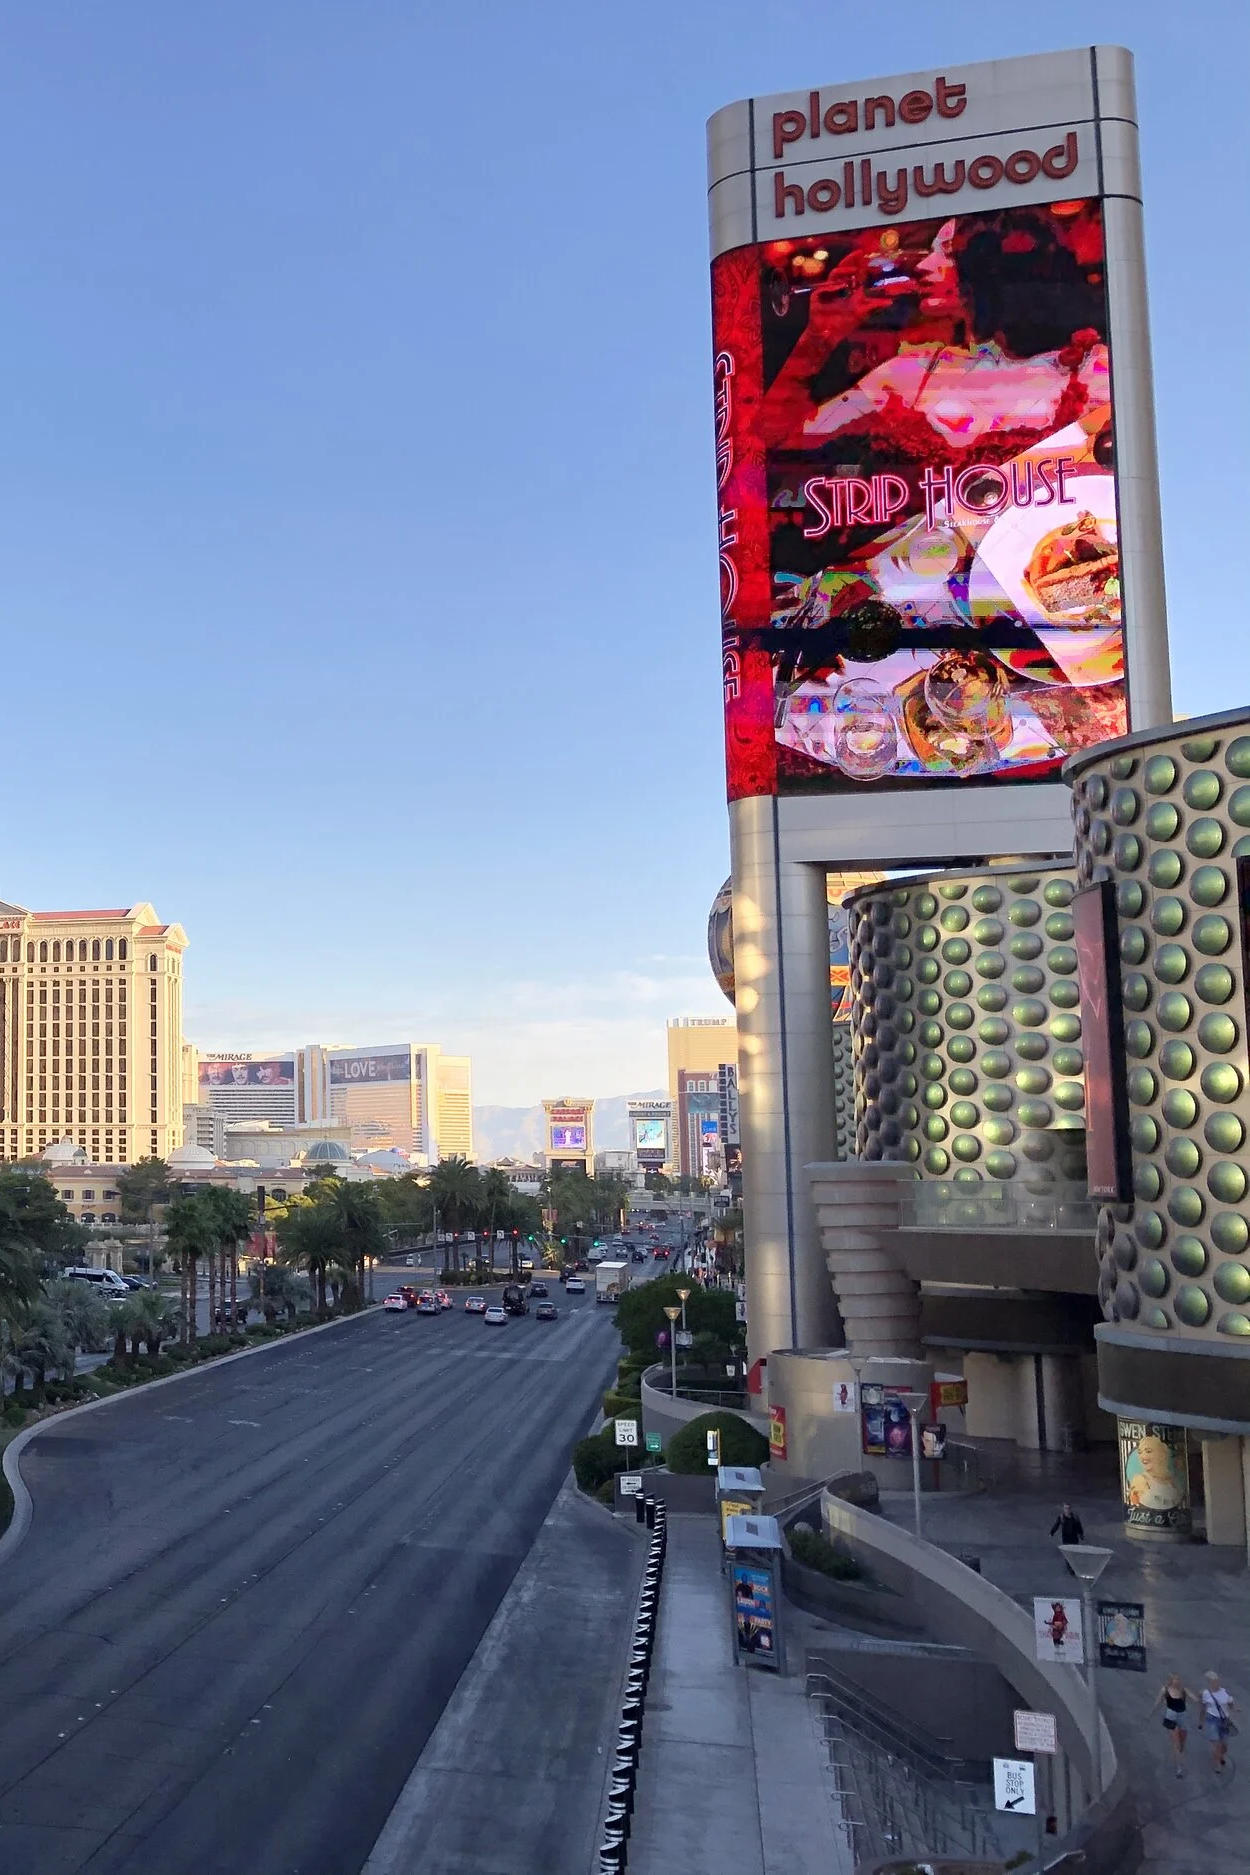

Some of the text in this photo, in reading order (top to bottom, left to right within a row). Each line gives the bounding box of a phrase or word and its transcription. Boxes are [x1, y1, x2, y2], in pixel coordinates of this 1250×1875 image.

[772, 77, 967, 159] planet
[774, 132, 1079, 218] hollywood
[803, 456, 1077, 537] STRIP HOUSE
[689, 1018, 727, 1026] TRUMP
[214, 1053, 252, 1061] MIRAGE
[344, 1061, 377, 1078] LOVE
[635, 1101, 672, 1109] MIRAGE
[619, 1434, 635, 1443] 30
[1007, 1771, 1022, 1780] BUS
[1006, 1780, 1024, 1788] STOP
[1006, 1787, 1025, 1795] ONLY
